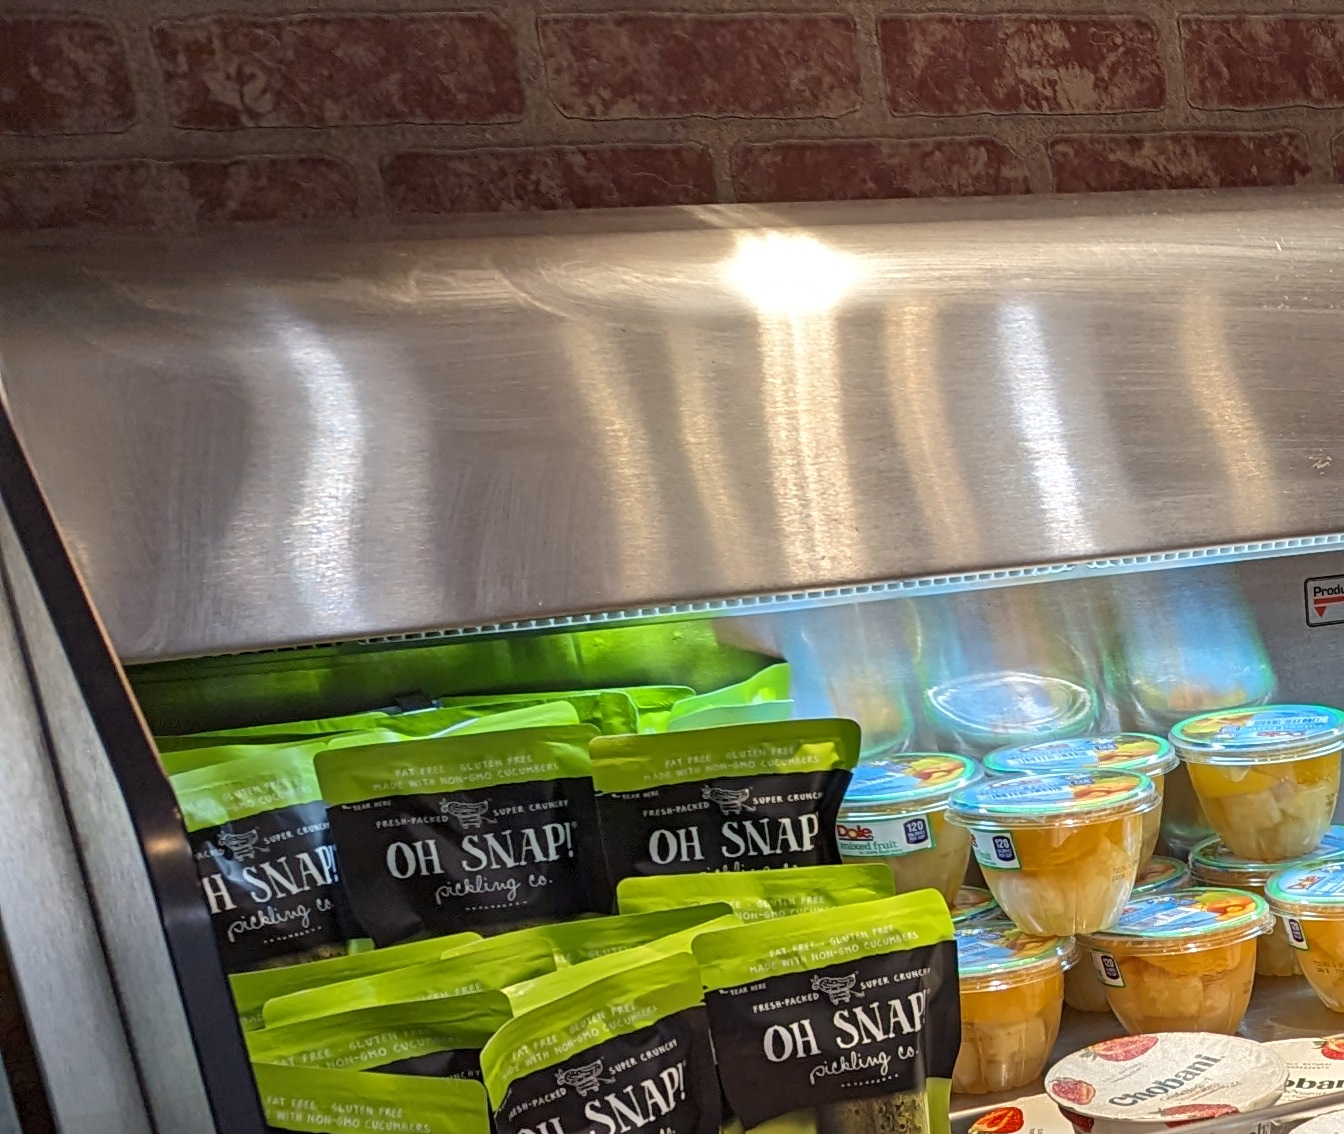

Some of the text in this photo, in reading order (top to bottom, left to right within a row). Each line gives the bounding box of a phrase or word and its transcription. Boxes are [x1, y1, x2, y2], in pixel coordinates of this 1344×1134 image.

[459, 755, 533, 773] GLUTEN FREE
[705, 759, 756, 772] NON-GMO
[439, 772, 492, 787] NON-GMO
[376, 806, 527, 829] FRESH-PACKED SUPER
[643, 795, 784, 817] FRESH-PACKED SUPER
[264, 831, 293, 845] SUPER
[650, 812, 819, 866] OH SNAP
[837, 825, 872, 839] Dole
[906, 822, 924, 833] 120
[386, 820, 574, 880] OH SNAP!
[873, 840, 898, 850] fruit
[995, 838, 1009, 849] 120
[242, 845, 339, 903] SNAP!
[435, 875, 521, 905] pickling
[227, 903, 312, 943] pickling
[829, 930, 870, 947] GLUTEN
[872, 924, 895, 939] FREE
[782, 931, 919, 970] WITH NON-GMO CUCUMBERS
[753, 992, 820, 1013] FRESH-PACKED
[860, 976, 891, 990] SUPER
[534, 1034, 558, 1049] FREE
[553, 1028, 599, 1054] NON-GMO
[763, 1018, 821, 1063] OH
[609, 1058, 638, 1075] SUPER
[640, 1038, 679, 1062] CRUNCHY
[810, 1050, 892, 1085] pickling
[331, 1102, 374, 1117] GLUTEN
[306, 1114, 360, 1129] NON-GMO
